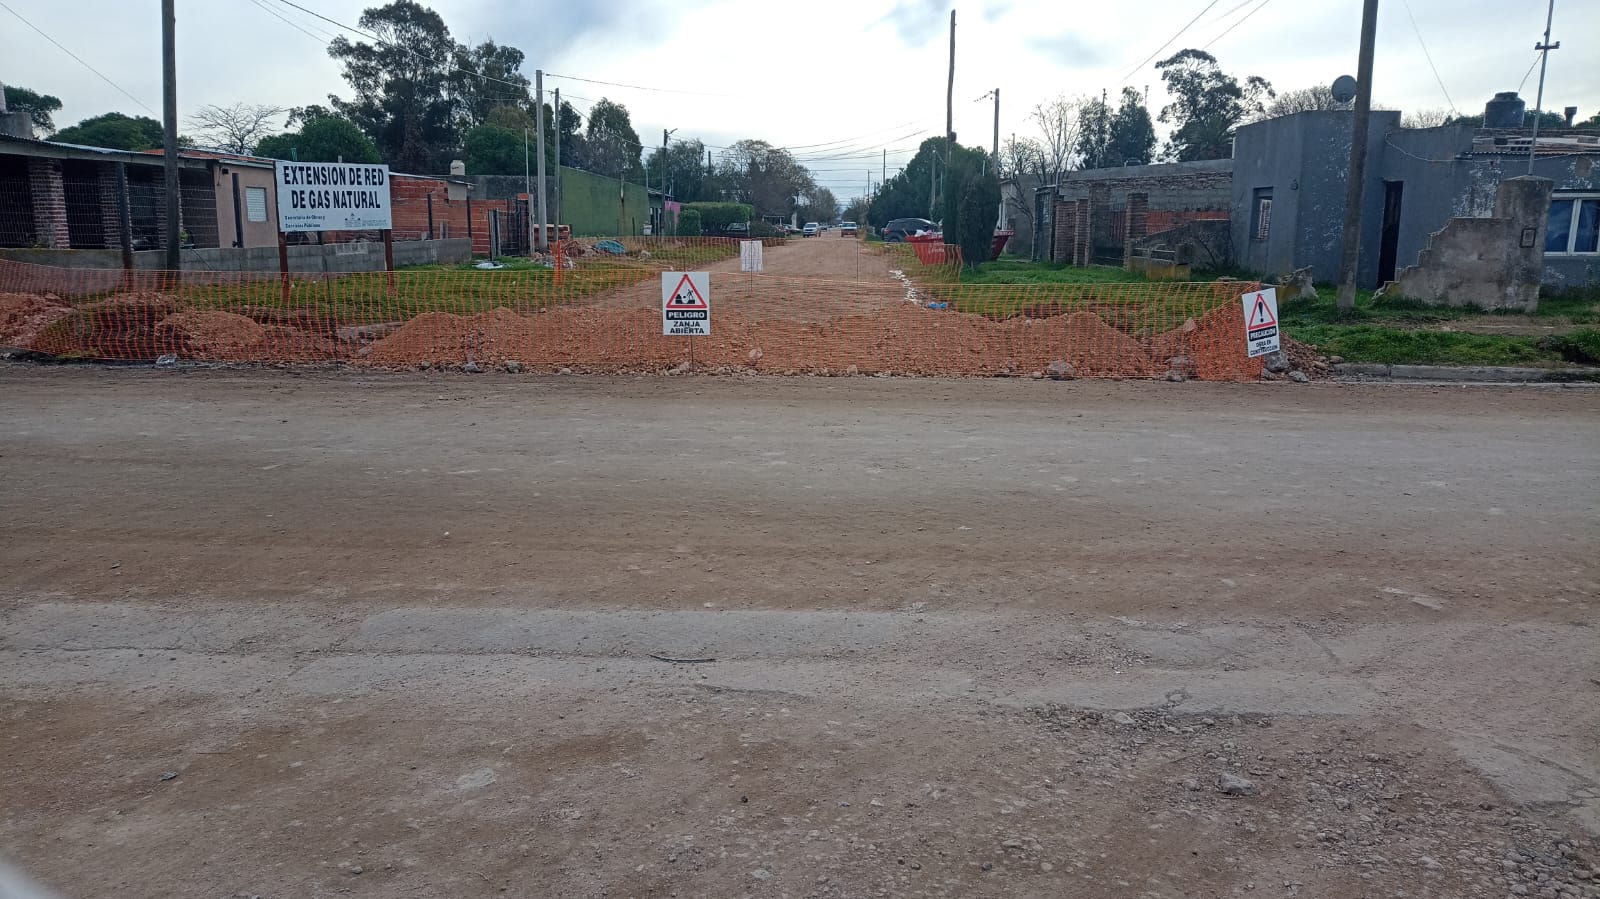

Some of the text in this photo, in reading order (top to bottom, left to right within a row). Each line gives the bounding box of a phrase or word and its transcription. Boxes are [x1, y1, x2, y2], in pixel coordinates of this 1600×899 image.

[283, 165, 384, 186] EXTENSION DE RED
[291, 190, 381, 209] DE GAS NATURAL
[668, 311, 705, 319] PELIGRO
